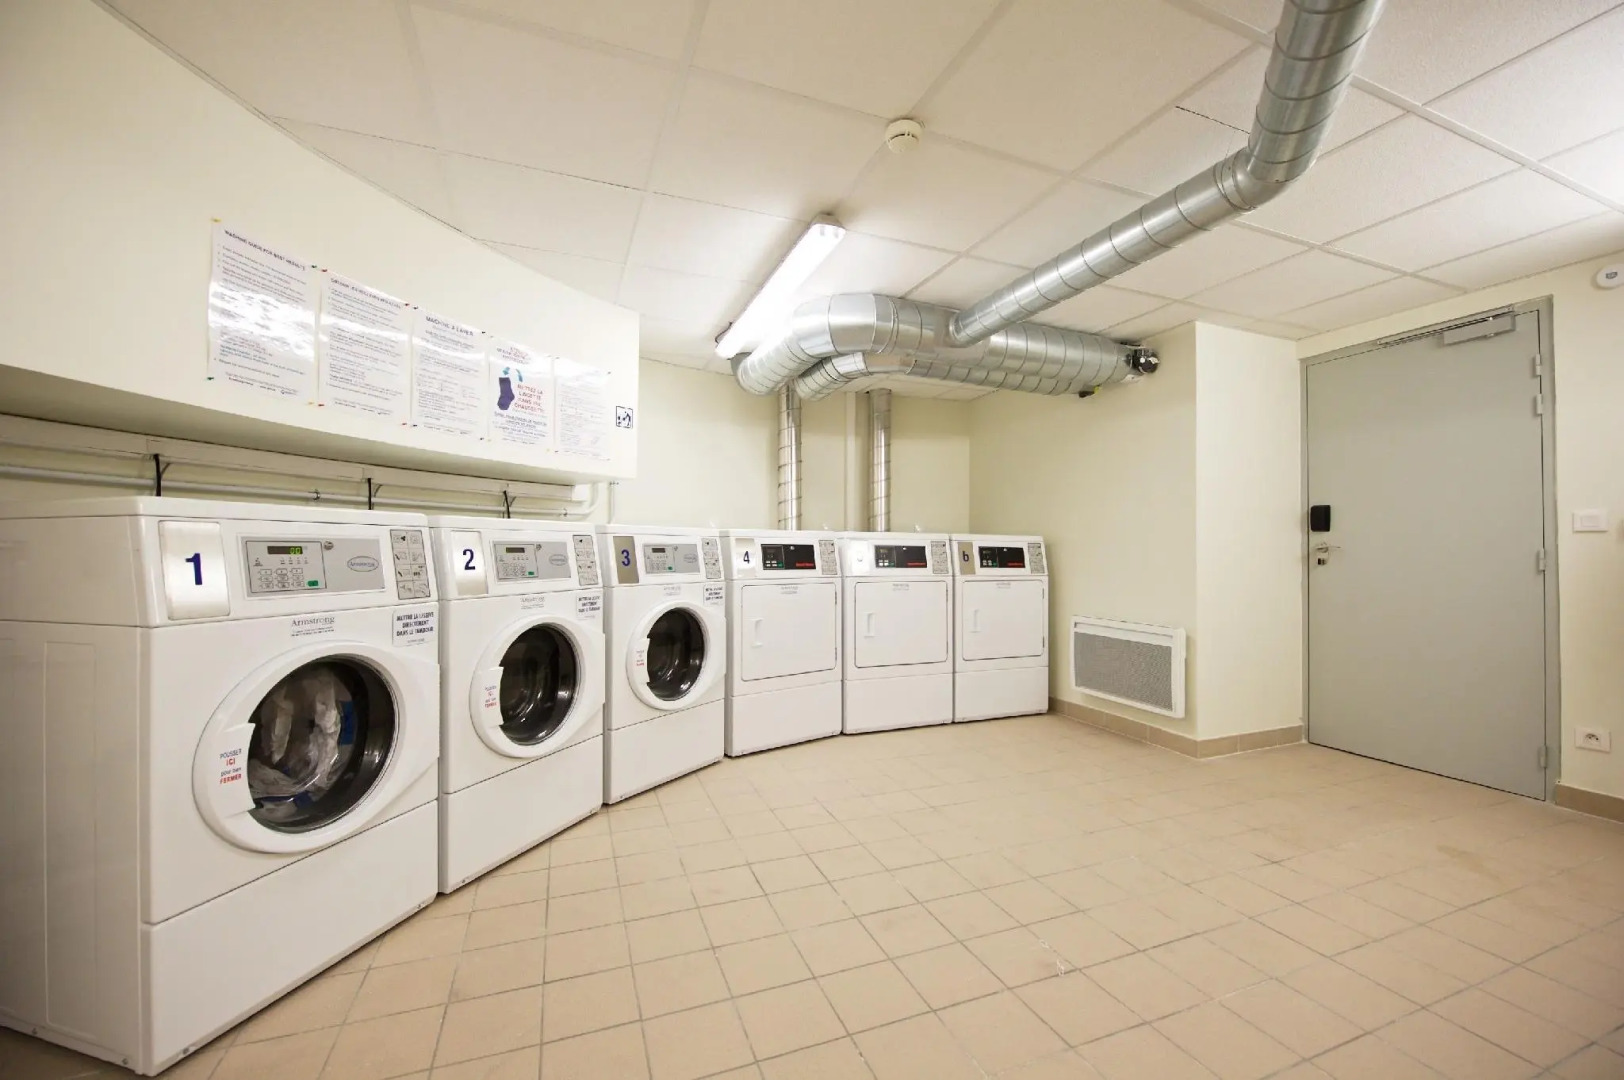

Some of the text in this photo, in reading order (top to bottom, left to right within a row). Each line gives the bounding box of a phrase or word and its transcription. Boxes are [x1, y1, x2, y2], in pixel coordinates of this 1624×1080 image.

[462, 548, 476, 571] 2
[621, 549, 631, 567] 3
[743, 550, 750, 564] 4
[185, 552, 203, 586] 1
[291, 617, 335, 627] Armstrong
